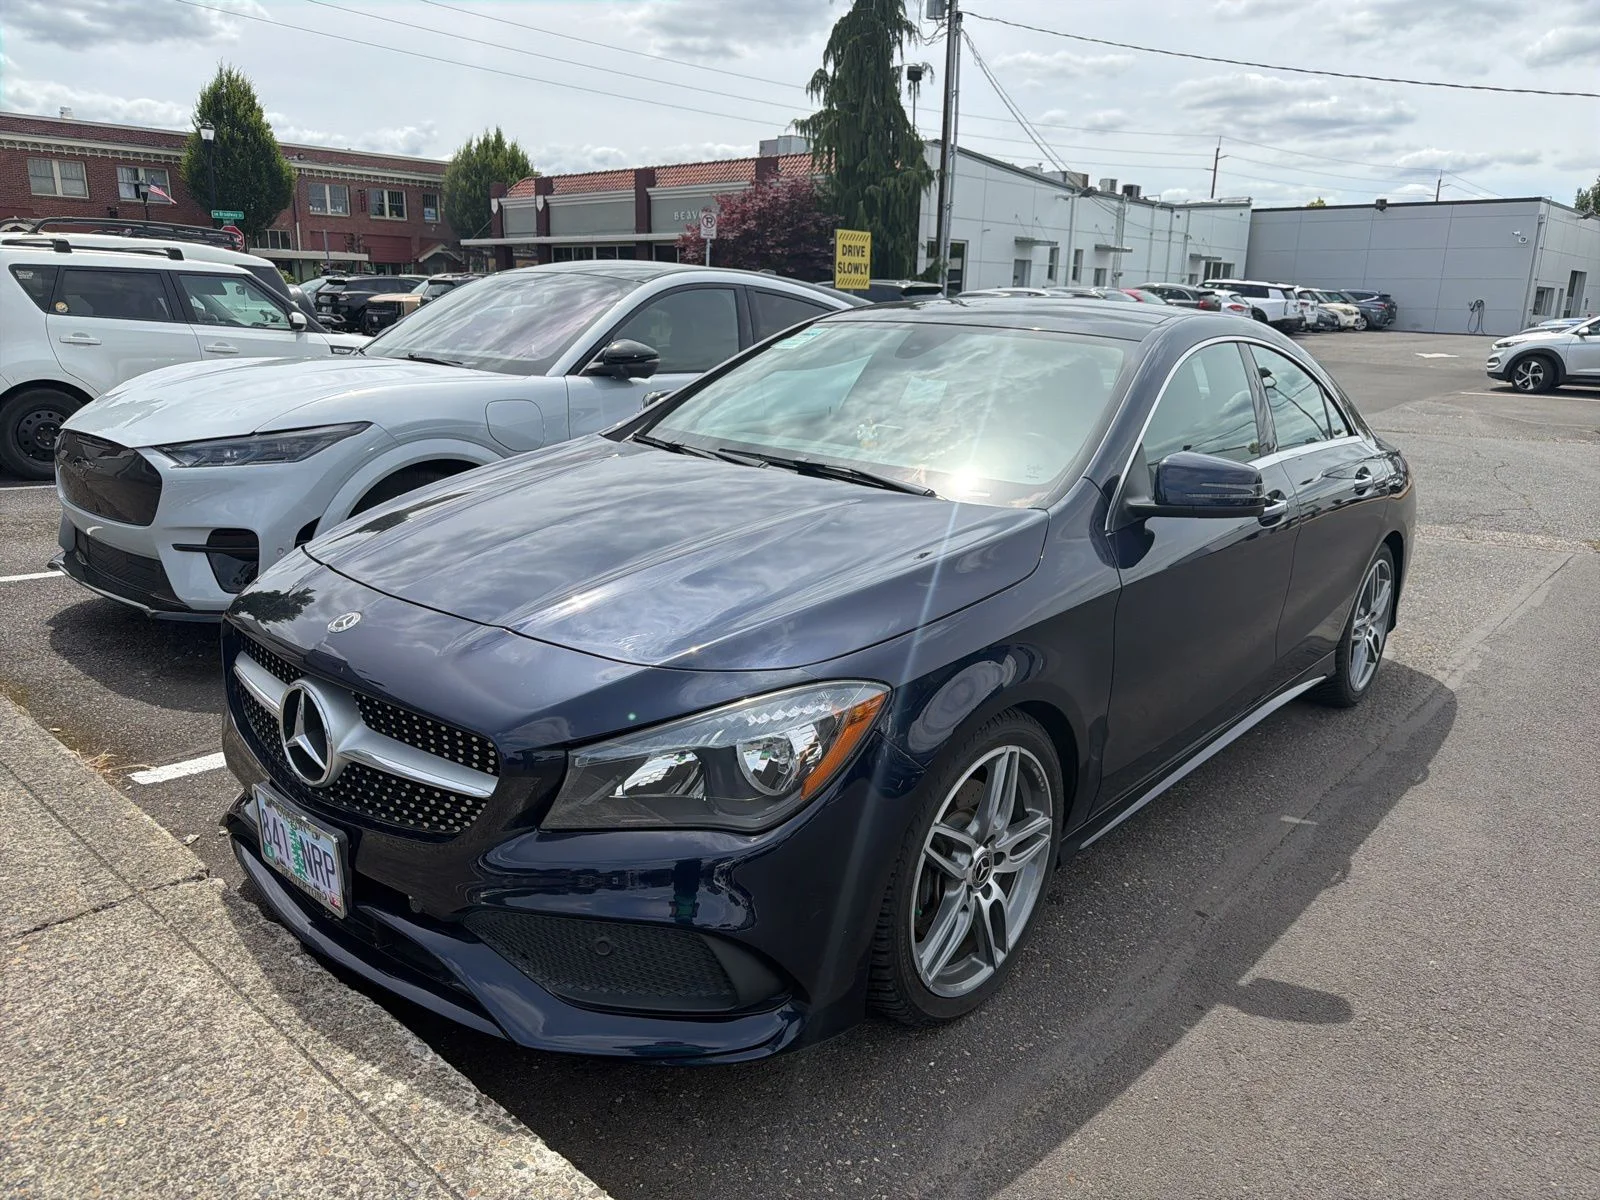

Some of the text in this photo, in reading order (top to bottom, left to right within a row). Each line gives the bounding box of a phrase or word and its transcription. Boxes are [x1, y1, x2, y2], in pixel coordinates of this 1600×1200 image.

[842, 244, 866, 257] DRIVE
[837, 261, 869, 275] SLOWLY
[261, 807, 291, 860] 841
[299, 833, 336, 889] NRP
